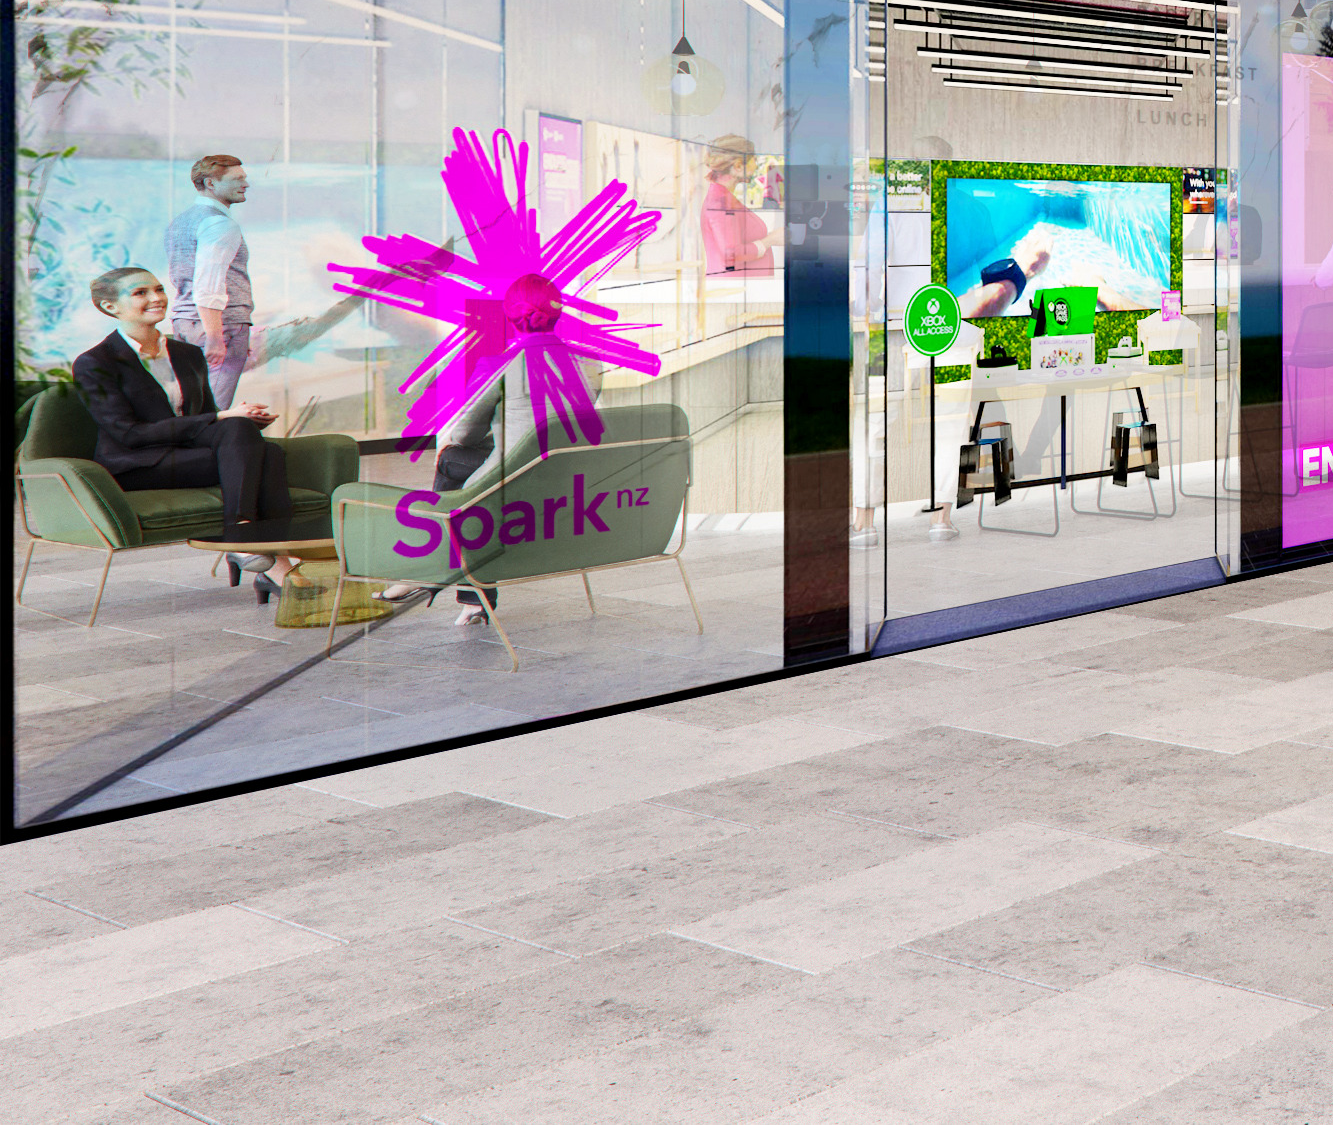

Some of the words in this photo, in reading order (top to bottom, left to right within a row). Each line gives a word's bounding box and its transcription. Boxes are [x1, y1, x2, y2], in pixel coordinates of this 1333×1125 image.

[1136, 109, 1208, 127] LUNCH
[920, 315, 946, 327] XBOX
[913, 328, 927, 336] ALL
[927, 325, 954, 335] ACCESS
[392, 473, 611, 569] Spark
[616, 487, 649, 509] nz
